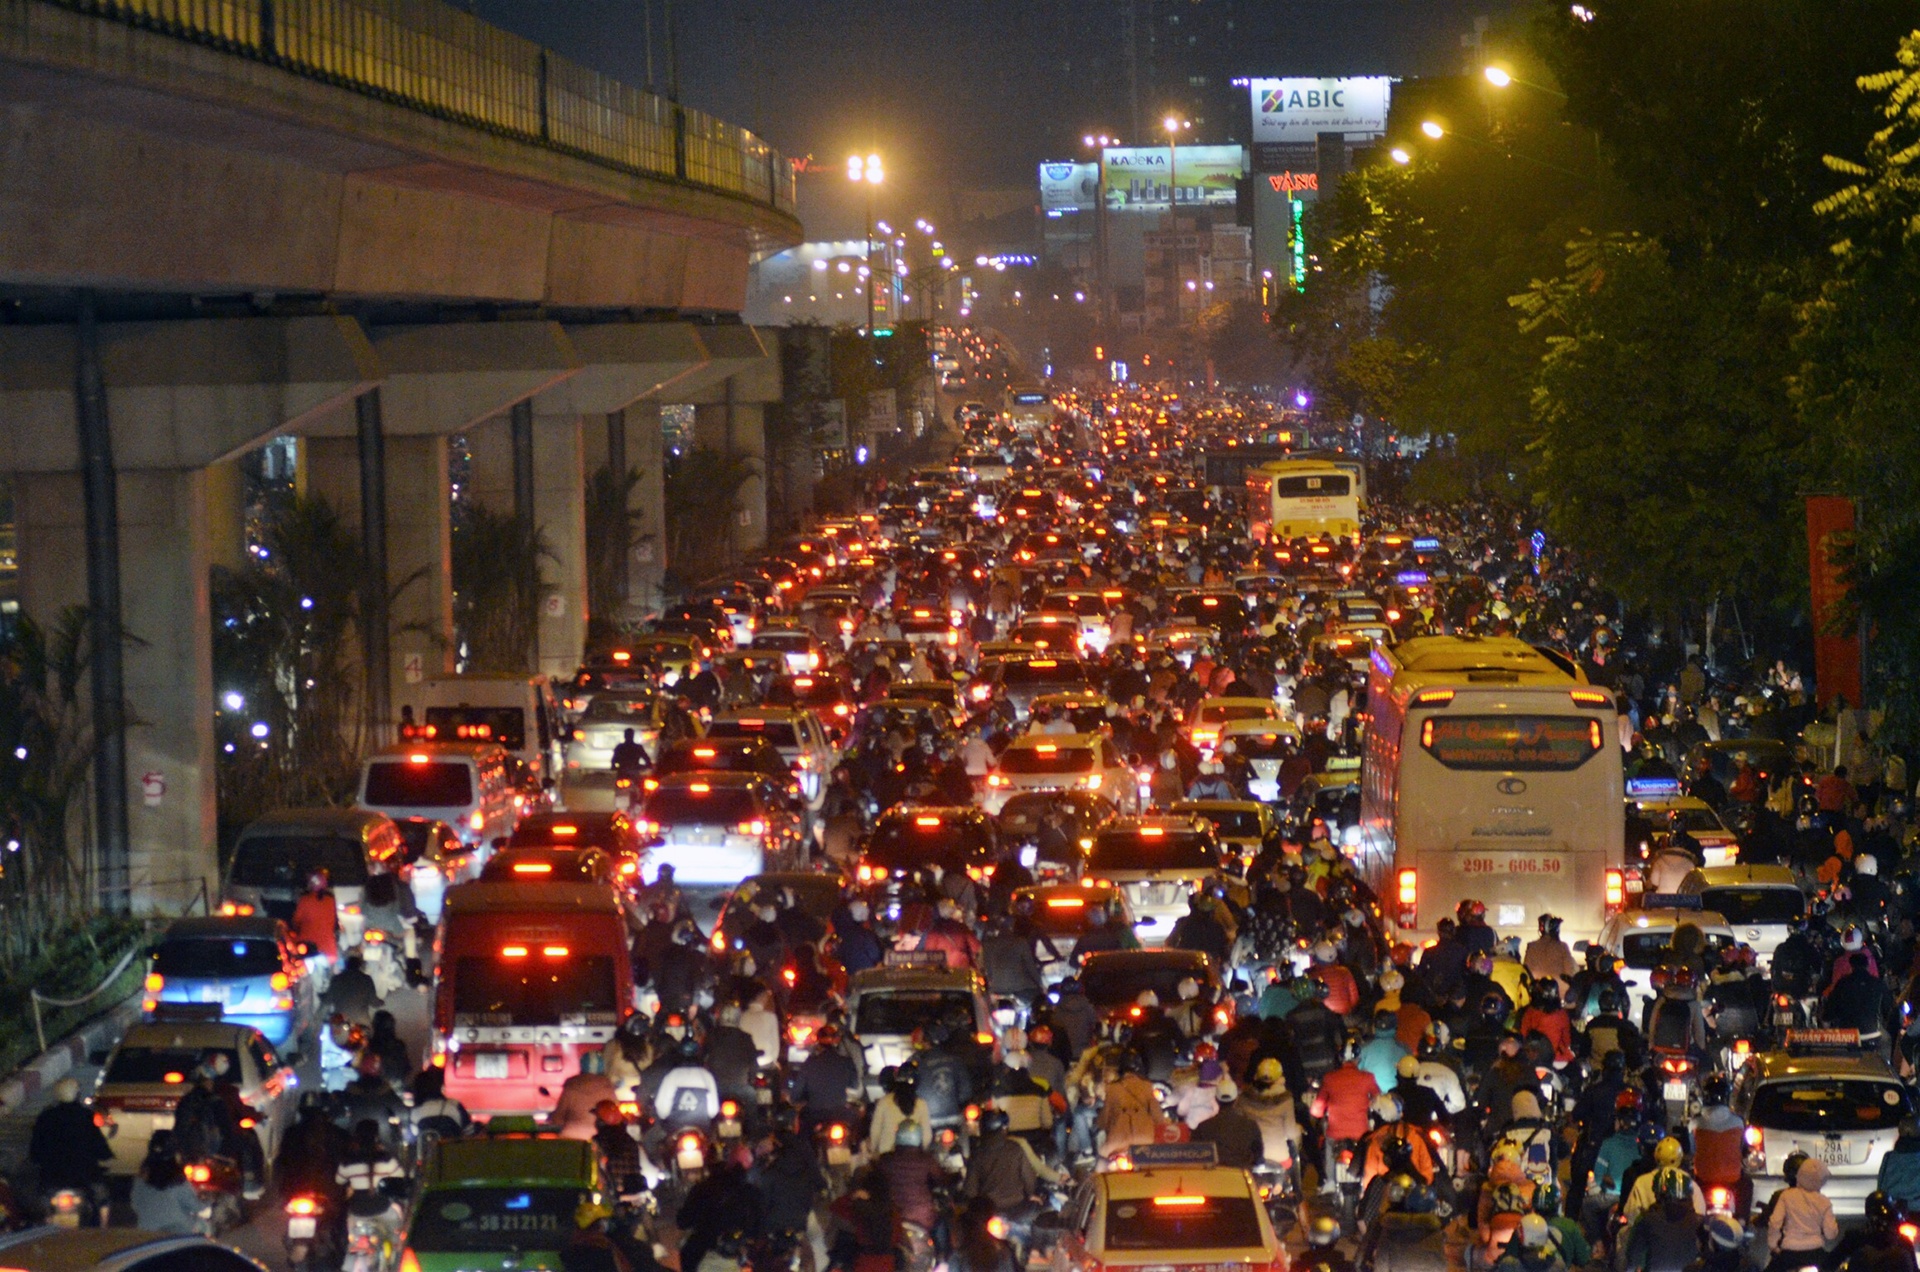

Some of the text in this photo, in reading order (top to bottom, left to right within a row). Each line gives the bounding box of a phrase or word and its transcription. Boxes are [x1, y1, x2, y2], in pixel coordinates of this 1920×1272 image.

[1288, 90, 1345, 108] ABIC
[405, 656, 422, 677] 4
[142, 771, 166, 798] 5
[1463, 858, 1494, 873] 29B
[1508, 858, 1560, 873] 606.50
[1824, 1140, 1842, 1153] 29A
